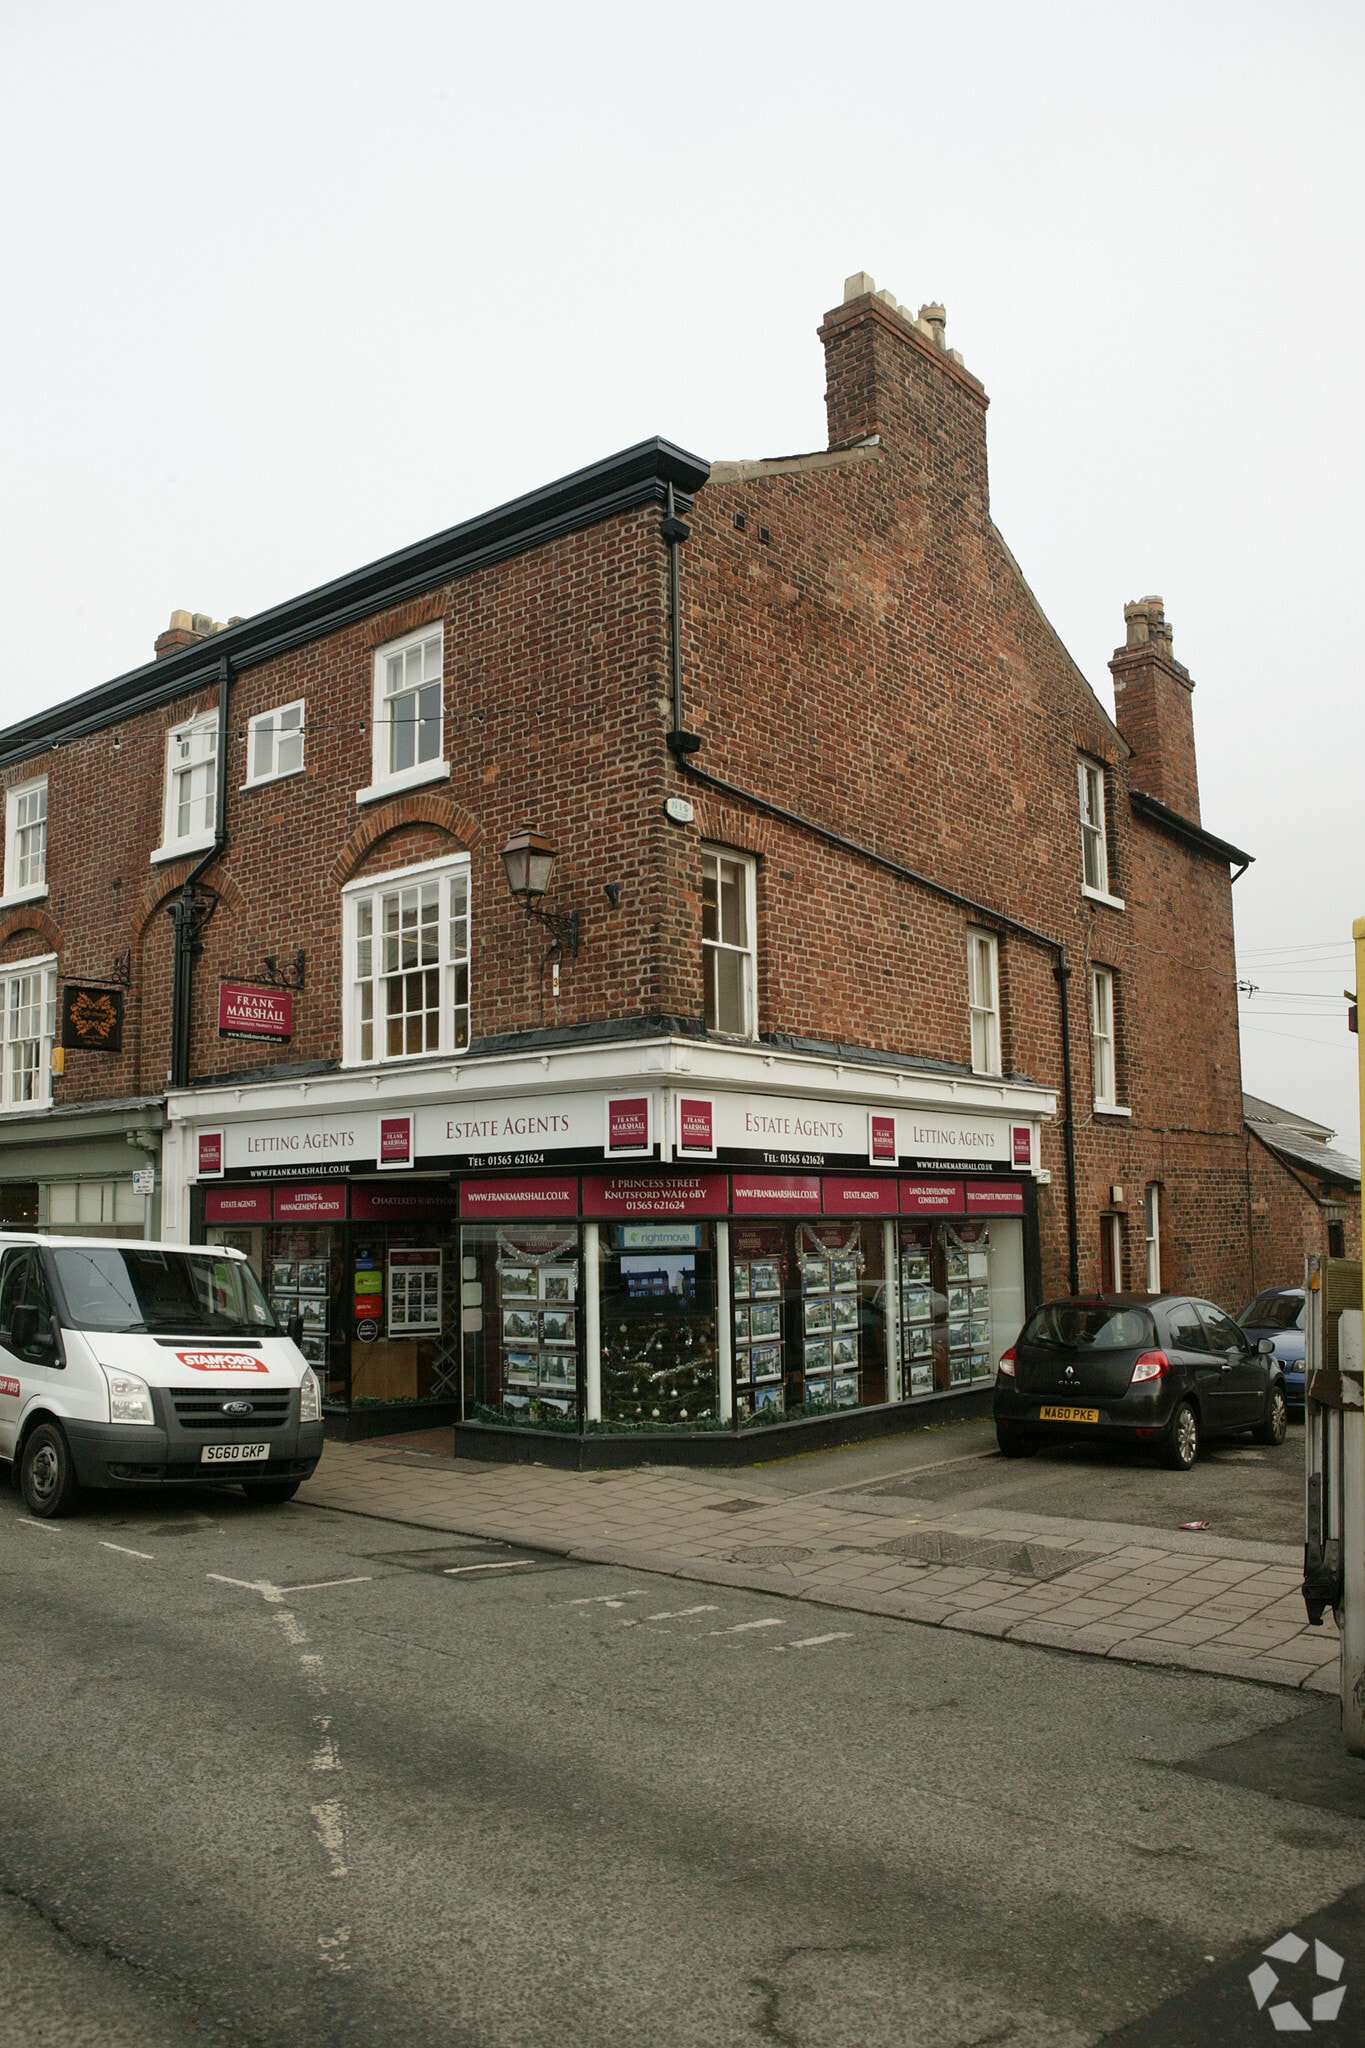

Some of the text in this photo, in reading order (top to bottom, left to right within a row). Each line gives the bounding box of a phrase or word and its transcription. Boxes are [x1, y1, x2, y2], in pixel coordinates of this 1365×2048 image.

[554, 978, 558, 987] 3
[237, 996, 274, 1008] FRANK
[226, 1005, 285, 1022] MARSHALL
[446, 1115, 568, 1139] ESTATE AGENTS
[612, 1122, 645, 1130] MARSHALL
[683, 1123, 710, 1131] MARSHALL
[746, 1113, 843, 1138] ESTATE AGENTS
[248, 1131, 354, 1152] LETTING AGENTS
[914, 1127, 995, 1147] LETTING AGENTS
[468, 1154, 544, 1166] TEL: 01565 621624
[763, 1153, 824, 1165] TEL: 01565 621624
[250, 1165, 350, 1177] WWW.FRANKMARSHALL.CO.UK
[916, 1161, 993, 1171] WWW.FRANKMARSHALL.CO.UK
[618, 1179, 664, 1188] PRINCESS
[666, 1179, 700, 1187] STREET
[468, 1192, 569, 1201] WWW.FRANKMARSHALL.CO.UK
[605, 1190, 707, 1199] KNUTSFORD WA16 6BY
[735, 1189, 818, 1199] WWW.FRANKMARSHALL.CO.UK
[843, 1191, 879, 1199] ESTATE AGENTS
[372, 1197, 417, 1205] CHARTERED
[626, 1201, 685, 1210] 01565 621624
[641, 1232, 690, 1244] rightmove
[184, 1354, 256, 1365] STAMFORD
[230, 1402, 248, 1412] Ford
[1044, 1408, 1094, 1420] MA60 PKE
[207, 1445, 264, 1459] SG60 GKP
